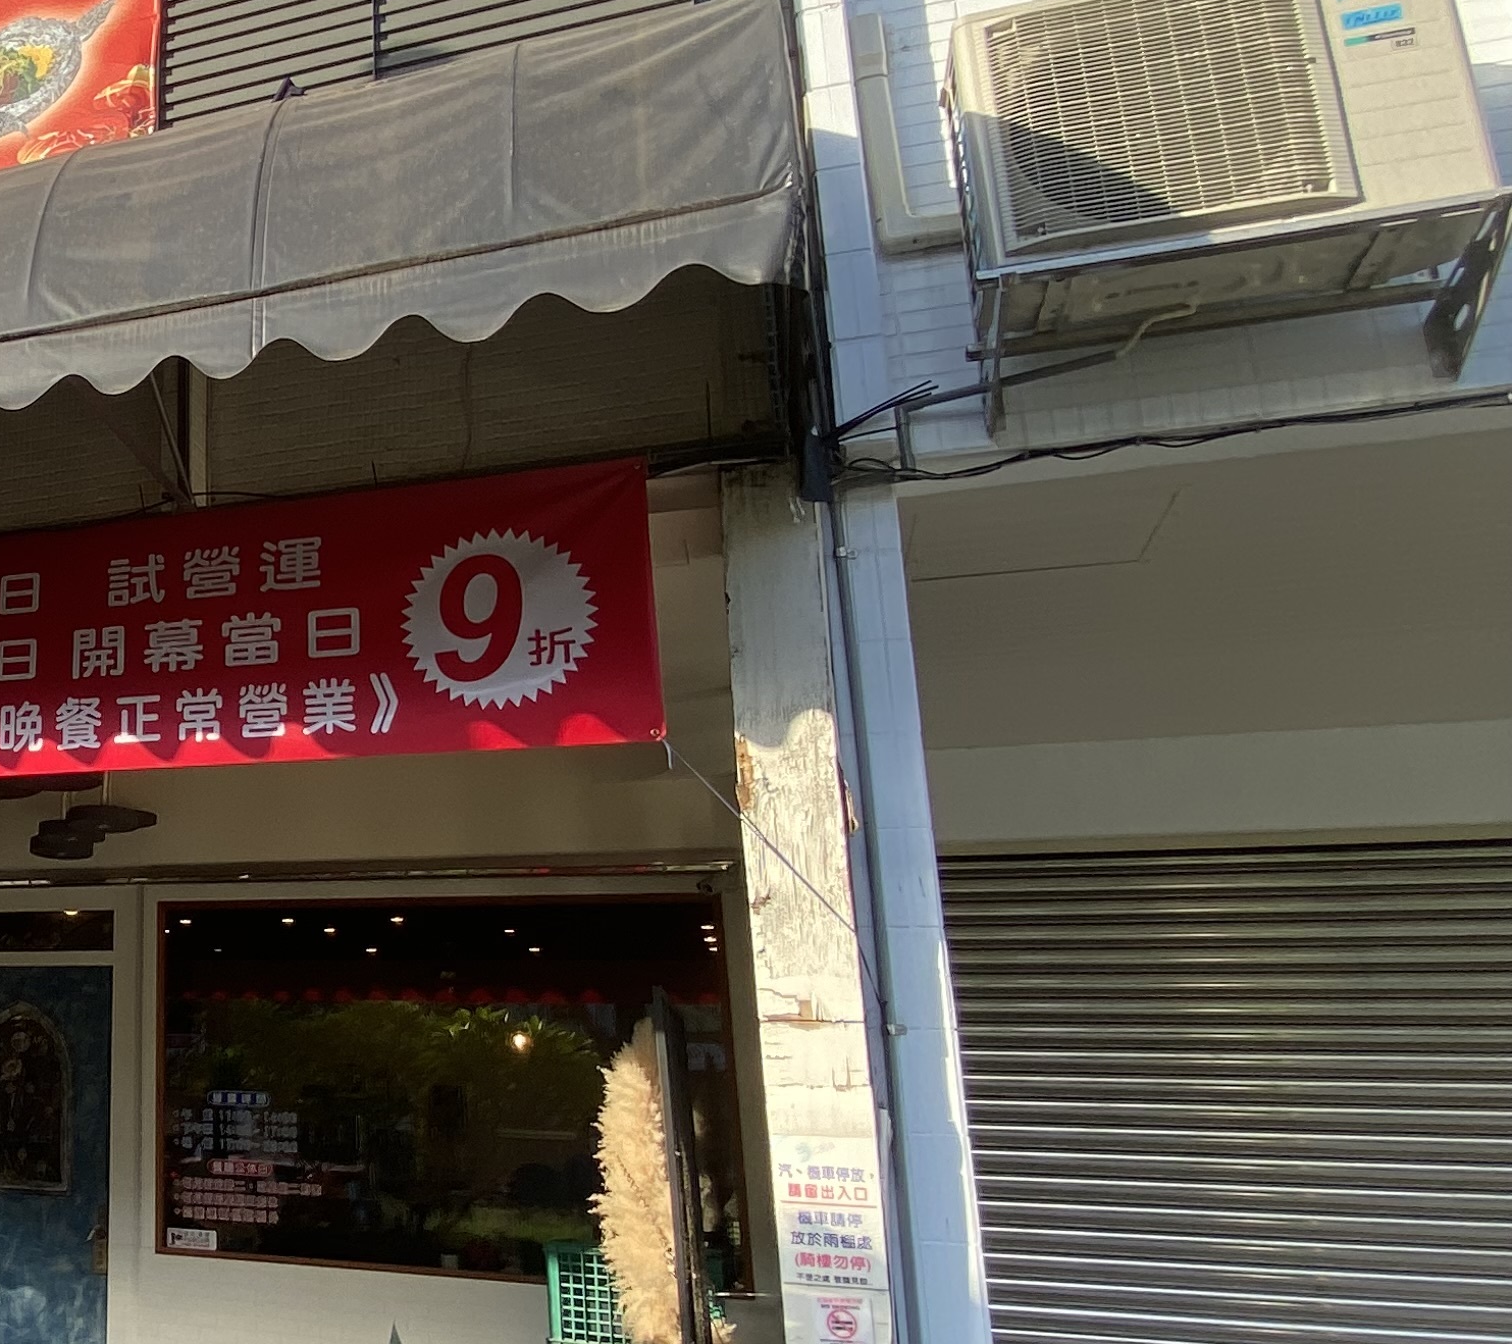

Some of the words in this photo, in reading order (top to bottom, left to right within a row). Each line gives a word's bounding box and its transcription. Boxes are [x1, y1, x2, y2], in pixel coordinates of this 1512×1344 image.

[107, 536, 323, 608] 試營運
[71, 607, 362, 680] 開幕當日
